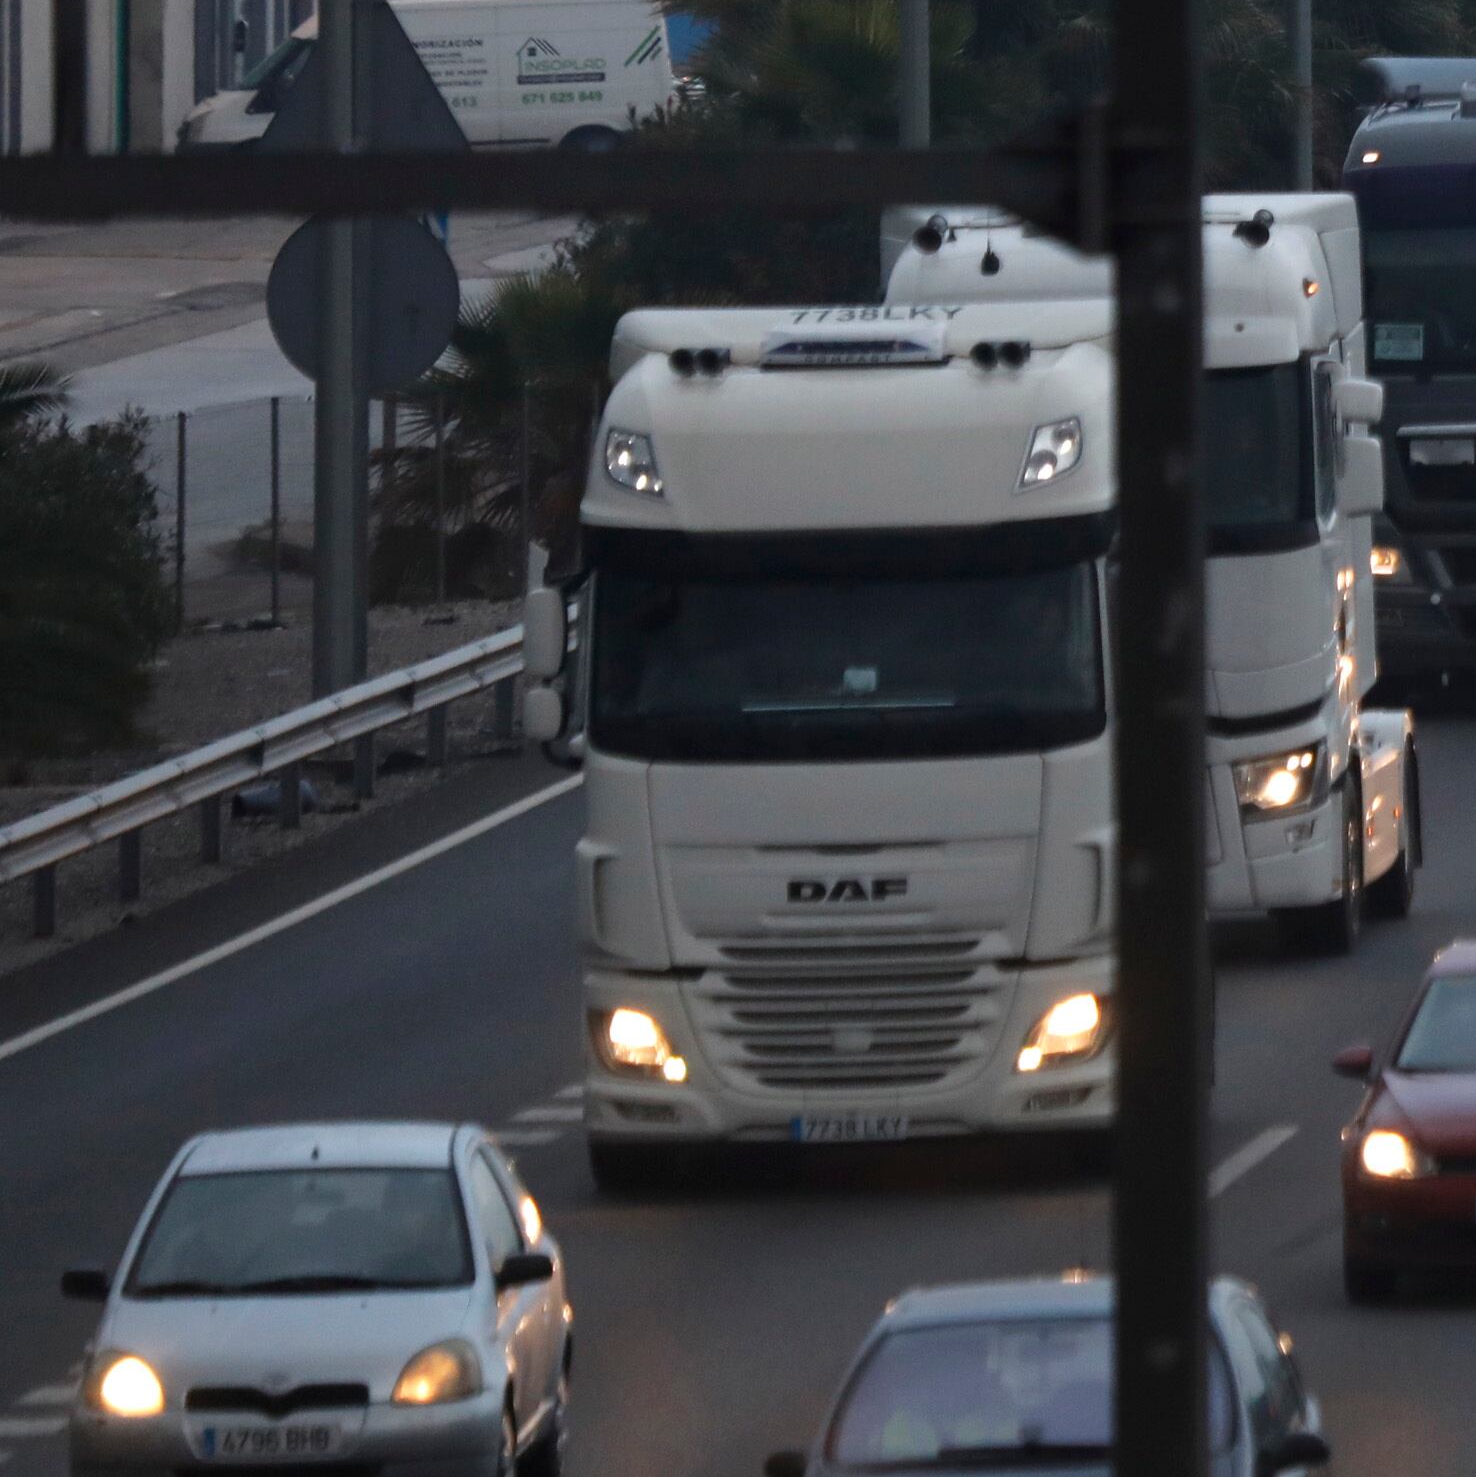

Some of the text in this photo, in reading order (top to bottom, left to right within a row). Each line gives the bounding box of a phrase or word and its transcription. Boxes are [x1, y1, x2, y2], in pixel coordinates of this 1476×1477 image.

[790, 305, 964, 326] 7738LKY
[787, 878, 908, 902] DAF
[862, 1116, 902, 1139] LKY
